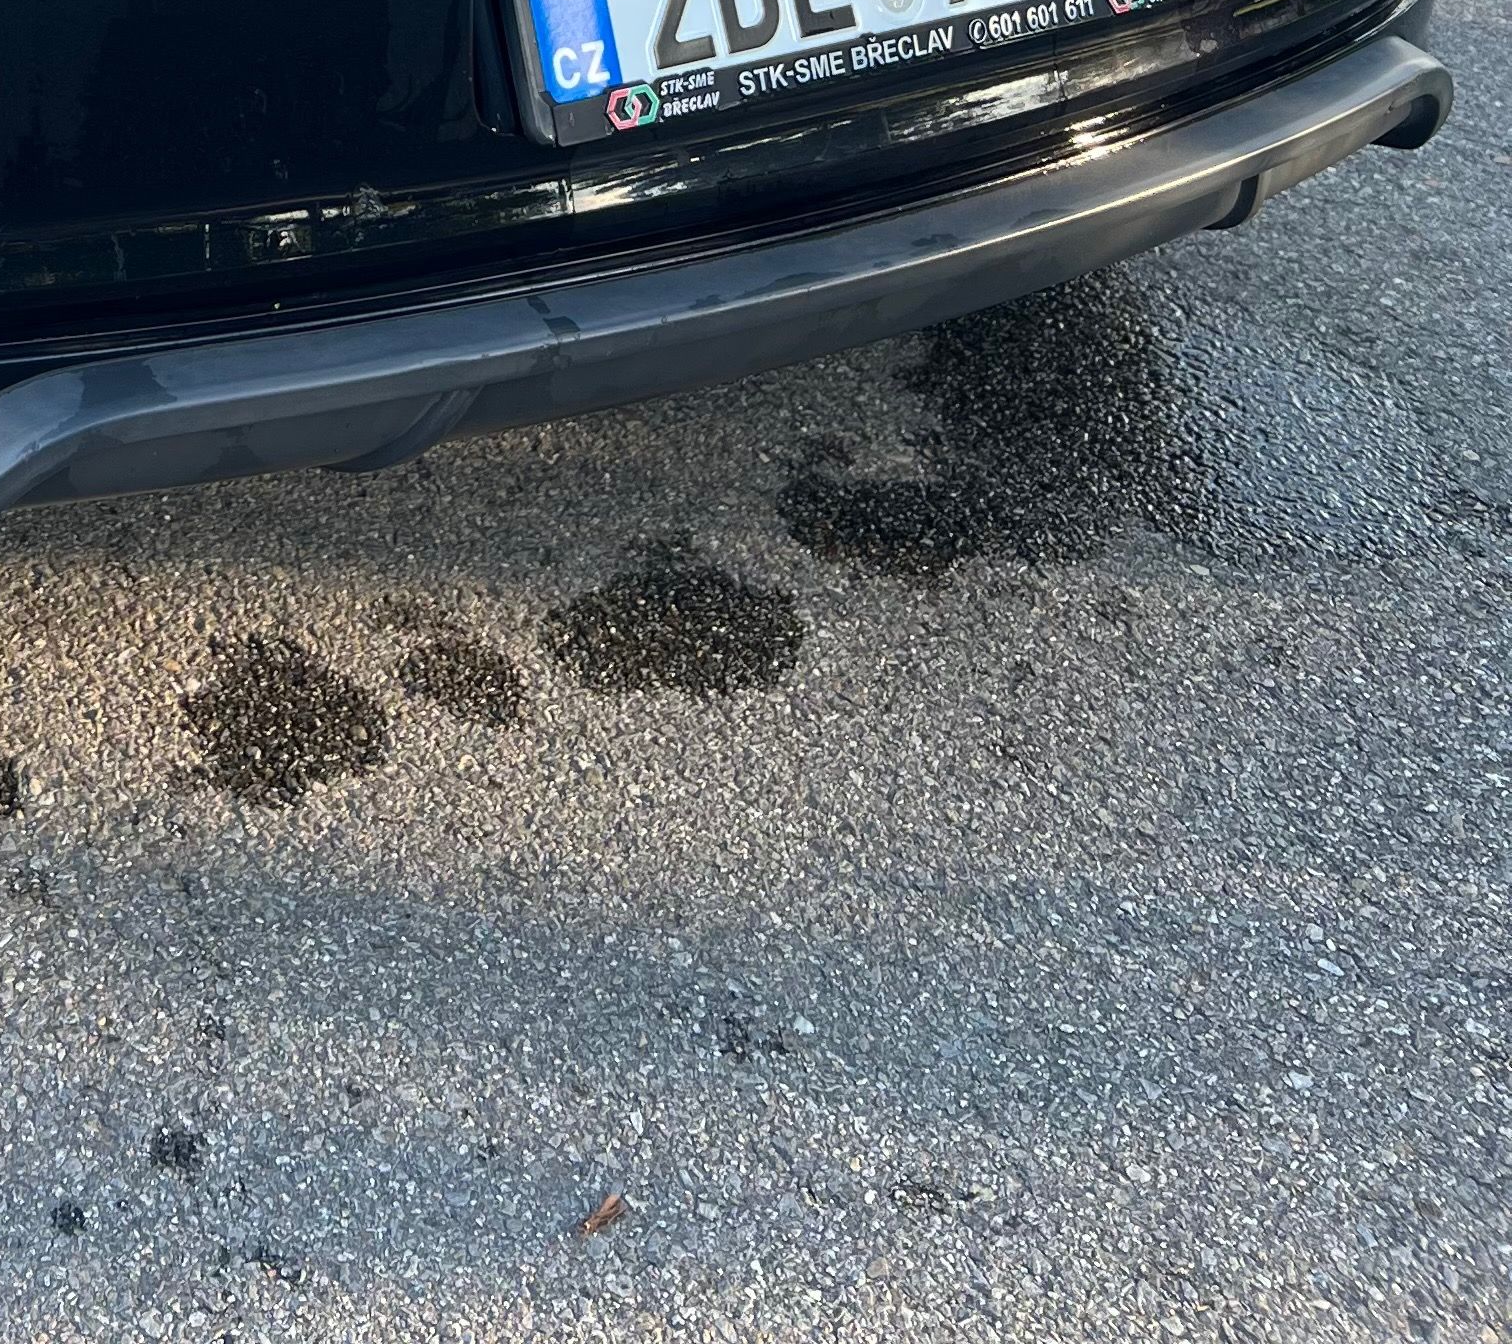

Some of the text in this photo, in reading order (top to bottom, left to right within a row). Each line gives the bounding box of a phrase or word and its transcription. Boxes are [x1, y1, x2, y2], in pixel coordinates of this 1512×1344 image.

[553, 39, 611, 91] CZ
[738, 50, 846, 96] STK-SME
[850, 25, 954, 70] BŘECLAV
[988, 13, 1022, 39] 601
[1026, 4, 1059, 29] 601
[660, 70, 715, 97] STK-SME
[662, 90, 721, 118] BŘECLAV
